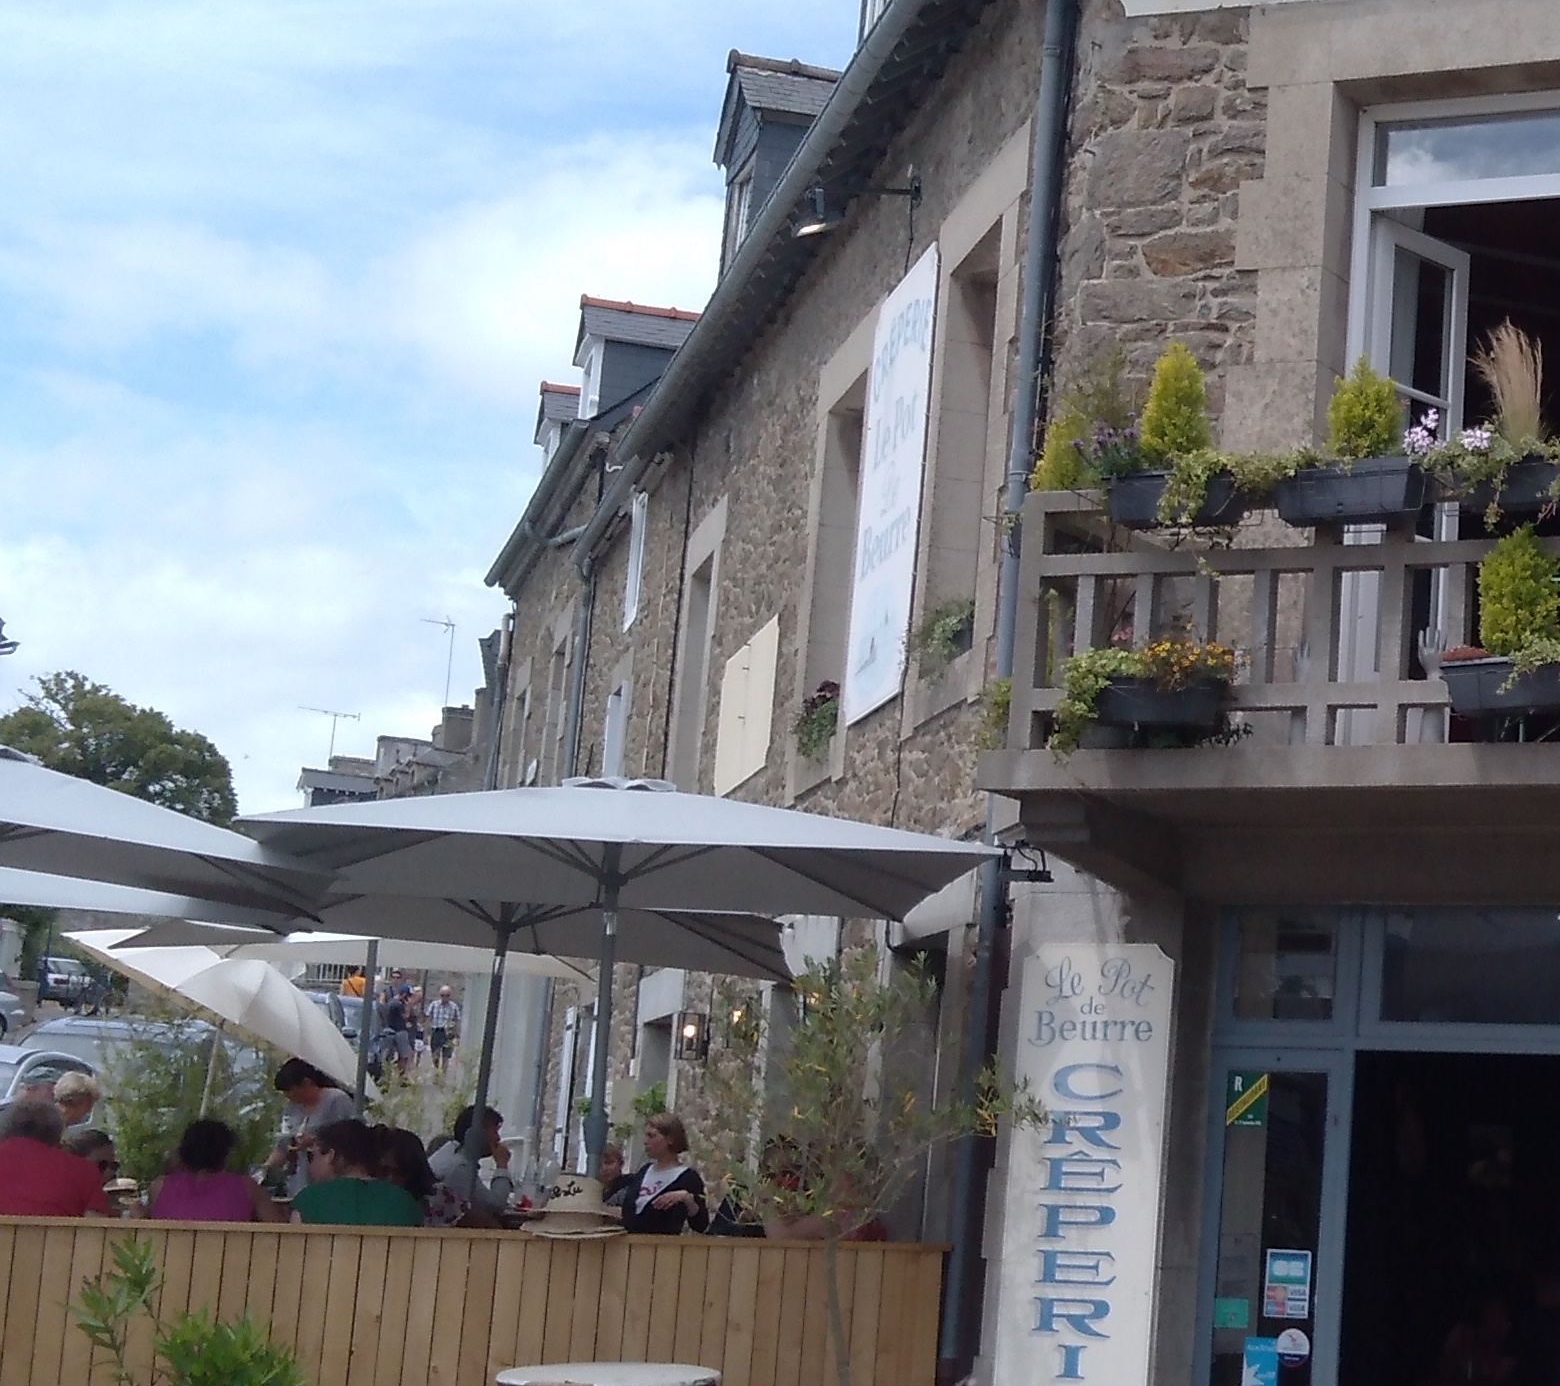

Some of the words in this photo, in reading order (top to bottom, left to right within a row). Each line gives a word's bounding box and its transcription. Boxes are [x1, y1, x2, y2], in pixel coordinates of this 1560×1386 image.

[893, 392, 919, 453] Pot
[860, 506, 912, 580] Beurre
[1045, 956, 1084, 1005] Le
[1098, 956, 1155, 1007] Pot
[1080, 995, 1106, 1015] de
[1027, 1010, 1154, 1047] Beurre
[1234, 1076, 1243, 1092] R
